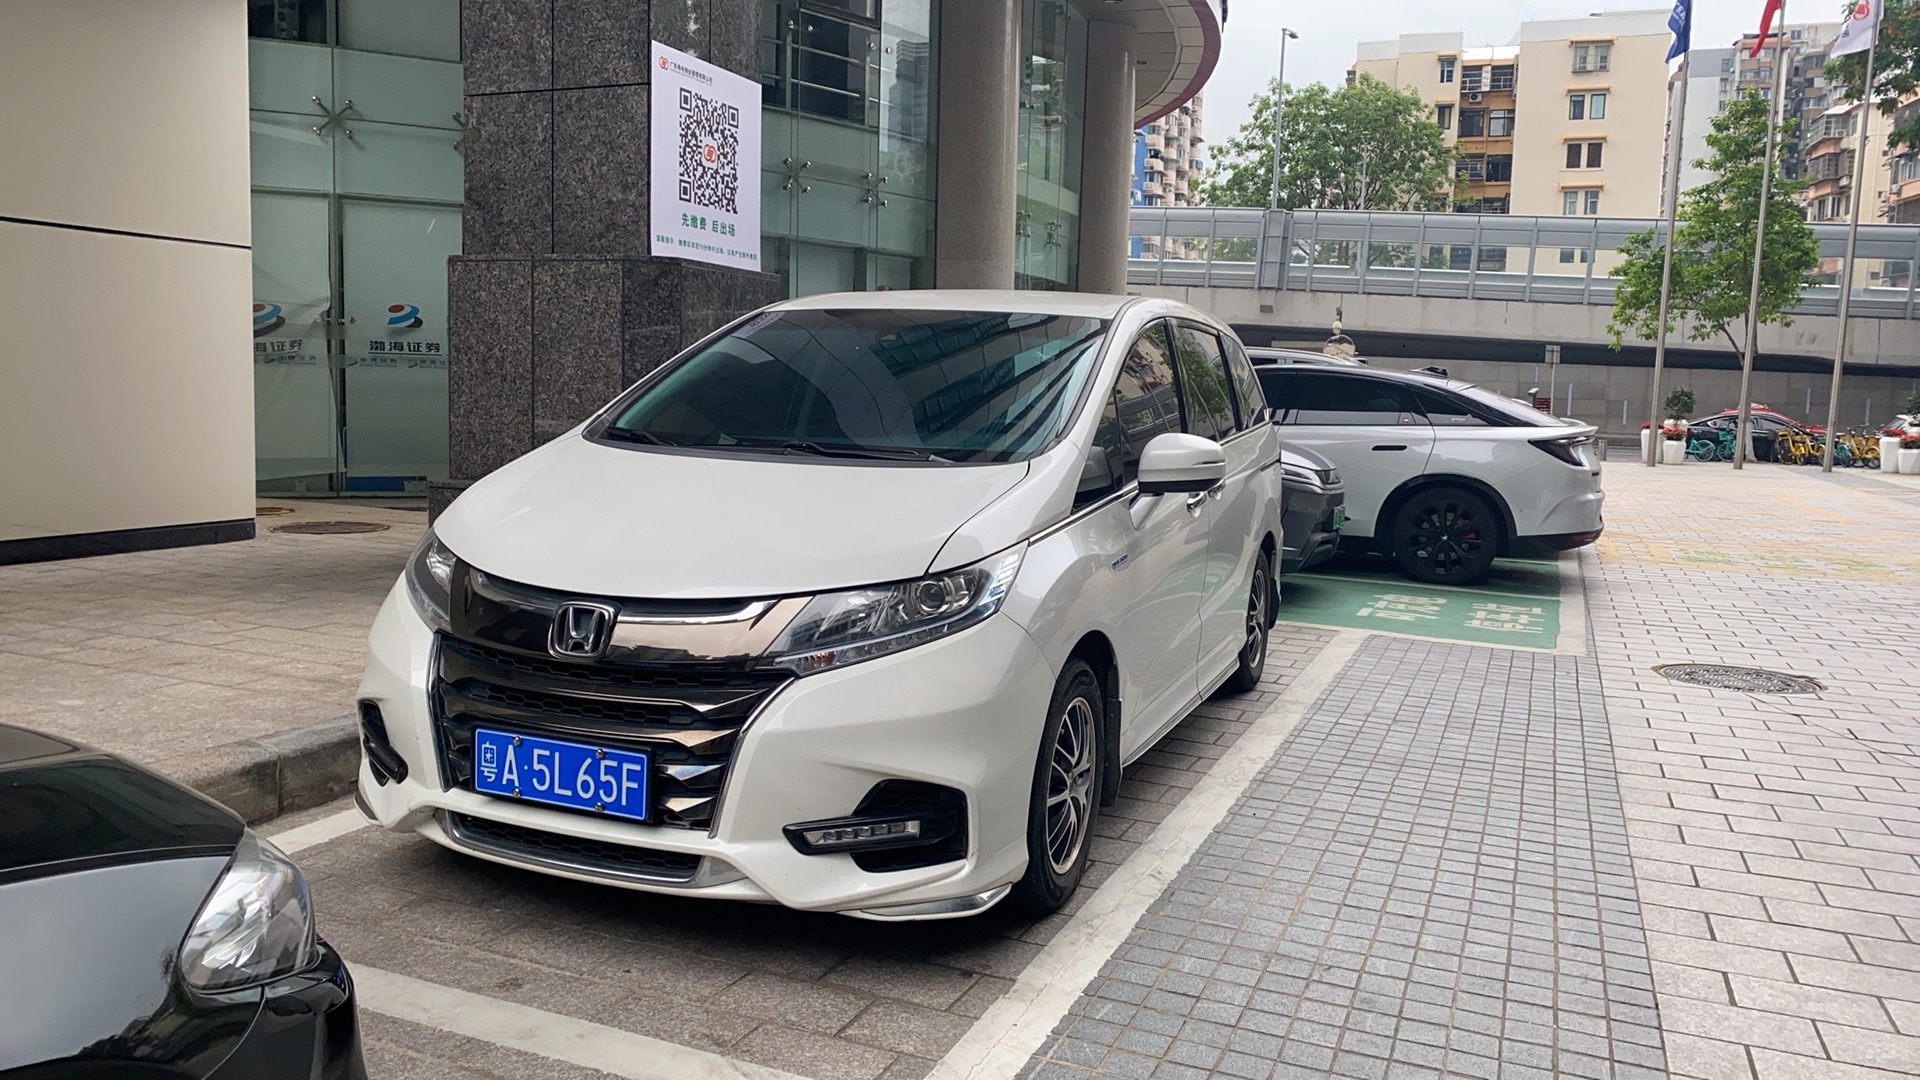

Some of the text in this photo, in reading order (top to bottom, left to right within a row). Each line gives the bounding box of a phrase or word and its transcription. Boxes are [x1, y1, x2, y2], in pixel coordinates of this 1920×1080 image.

[681, 212, 736, 237] 先缴费 后出场
[369, 341, 441, 353] 渤海证券
[481, 741, 642, 806] 粤A·5L65F
